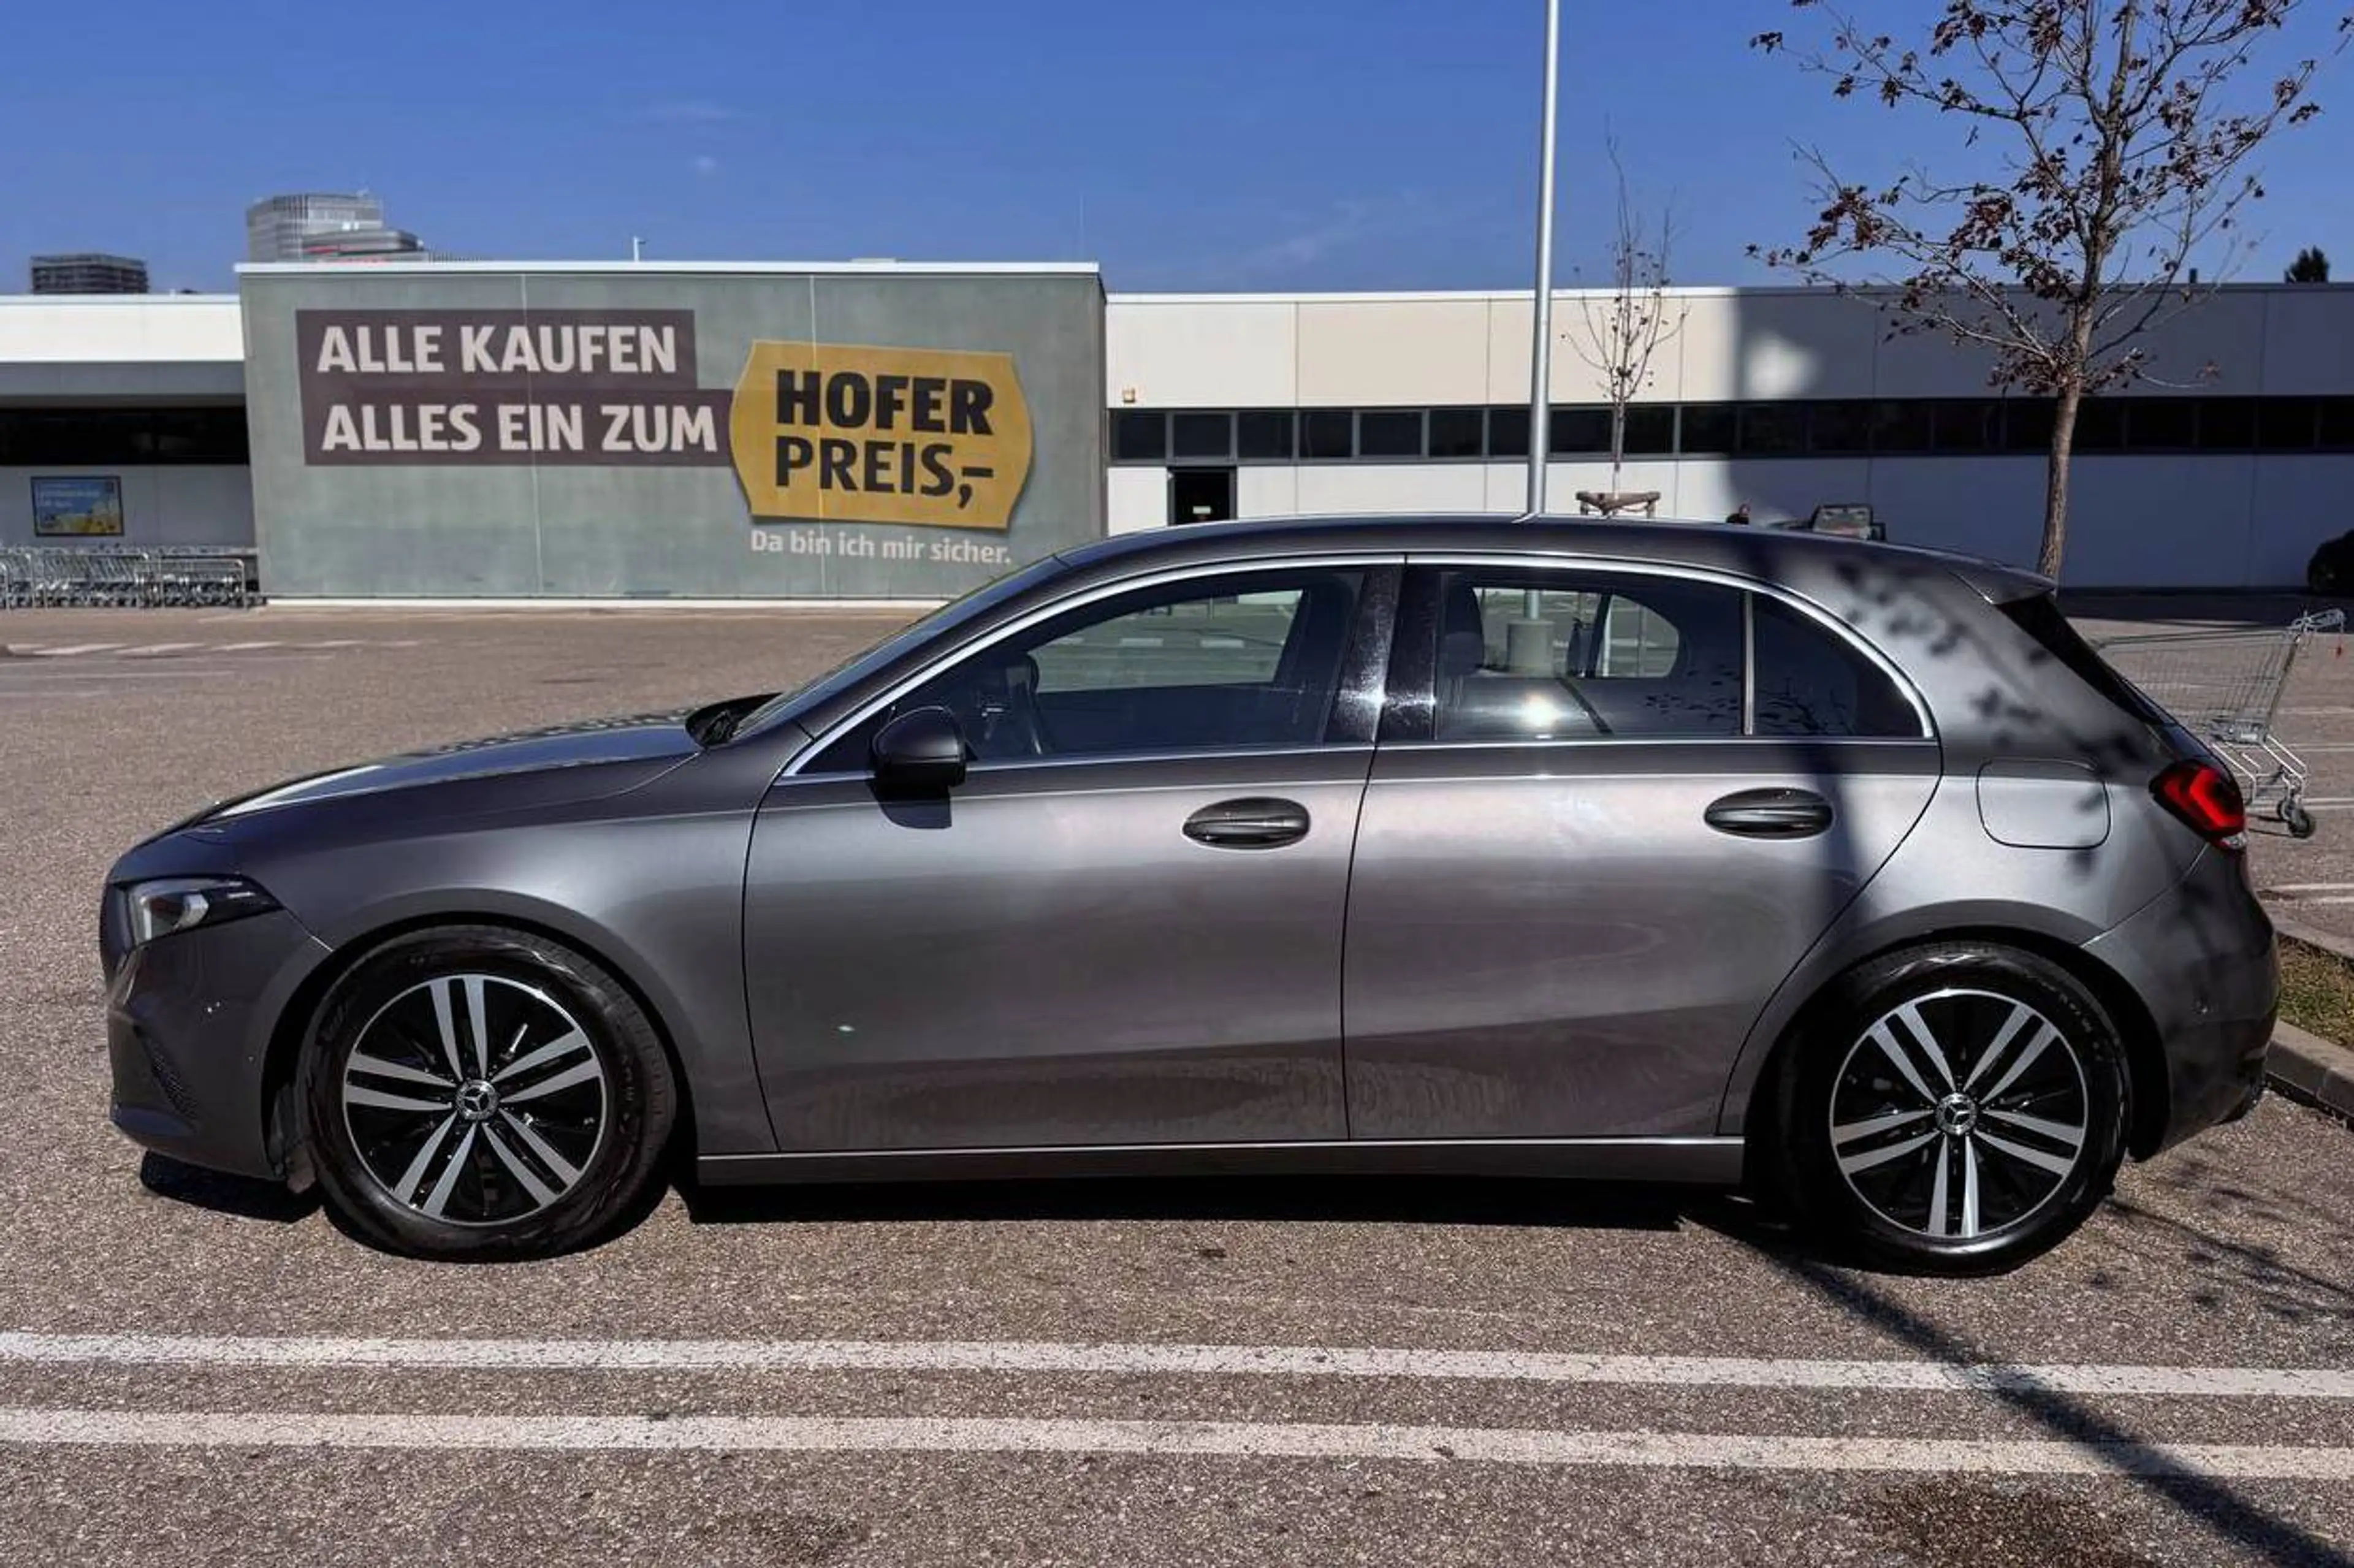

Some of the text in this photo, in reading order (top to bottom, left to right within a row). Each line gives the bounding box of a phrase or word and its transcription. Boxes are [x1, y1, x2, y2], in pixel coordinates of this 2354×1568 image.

[316, 325, 677, 373] ALLE KAUFEN
[776, 369, 993, 435] HOFER
[321, 404, 718, 452] ALLES EIN ZUM
[751, 530, 1011, 563] Da bin ich mir sicher.
